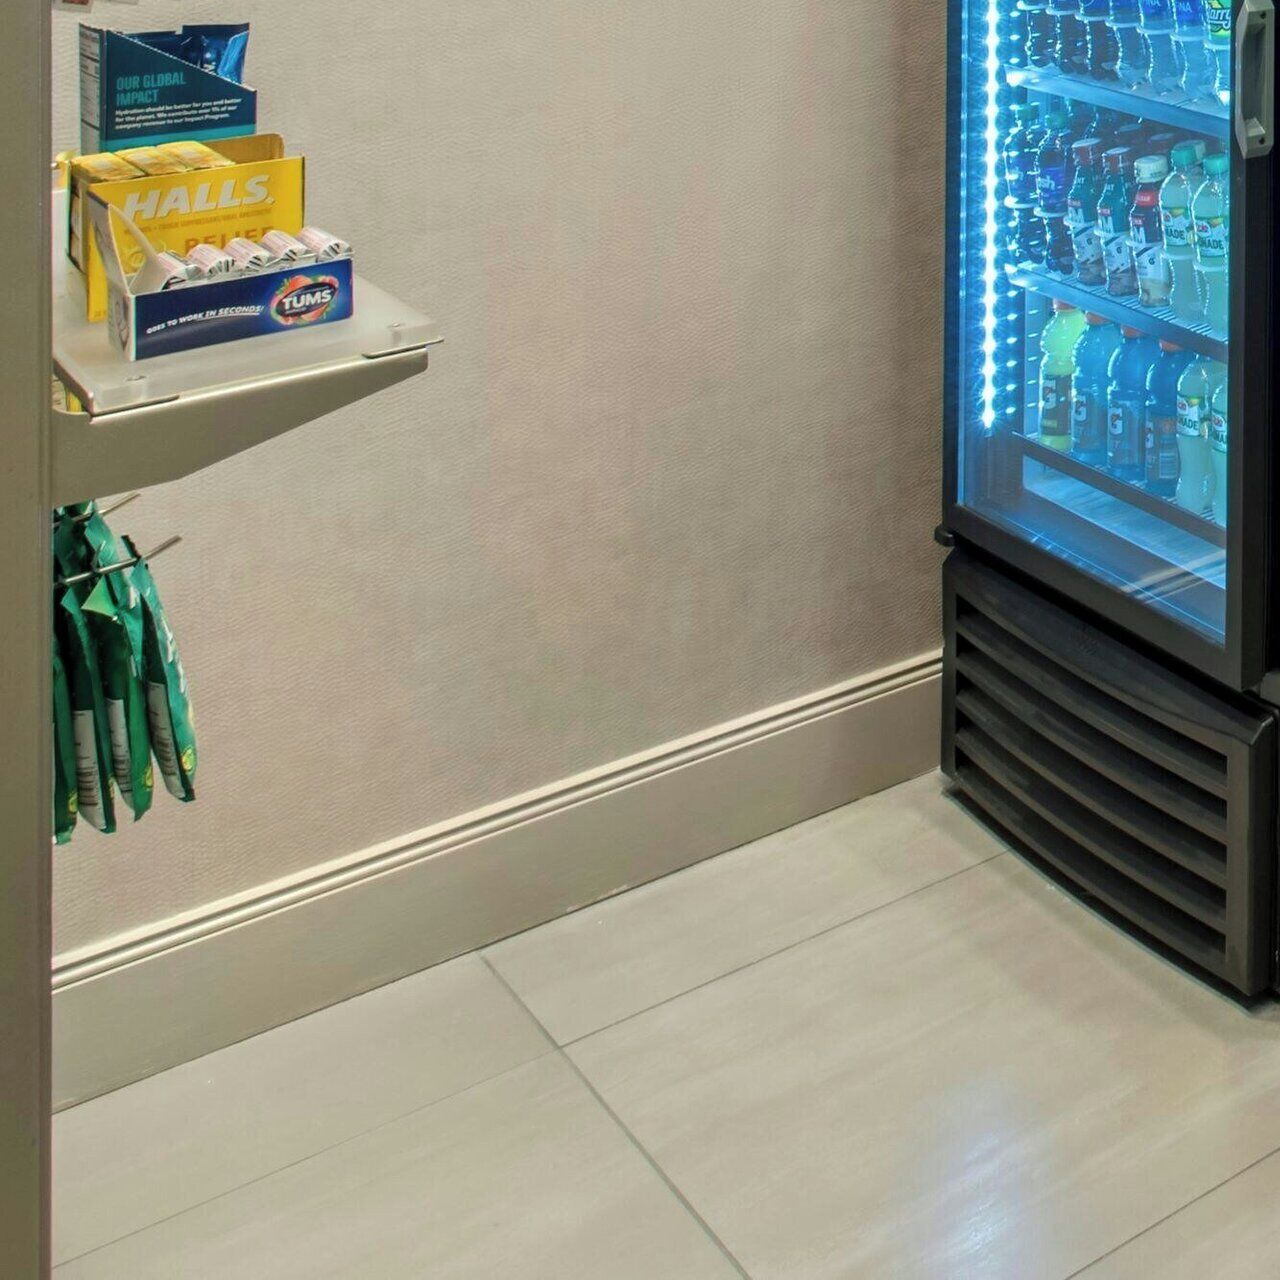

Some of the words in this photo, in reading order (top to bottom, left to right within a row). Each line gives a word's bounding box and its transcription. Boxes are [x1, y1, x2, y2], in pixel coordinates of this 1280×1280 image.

[116, 74, 140, 91] OUR
[143, 71, 187, 88] GLOBAL
[116, 90, 159, 107] IMPACT
[124, 174, 271, 221] HALLS
[283, 289, 332, 311] TUMS
[167, 318, 178, 327] TO
[179, 312, 203, 325] WORK
[205, 309, 216, 320] IN
[218, 304, 264, 317] SECONDS!
